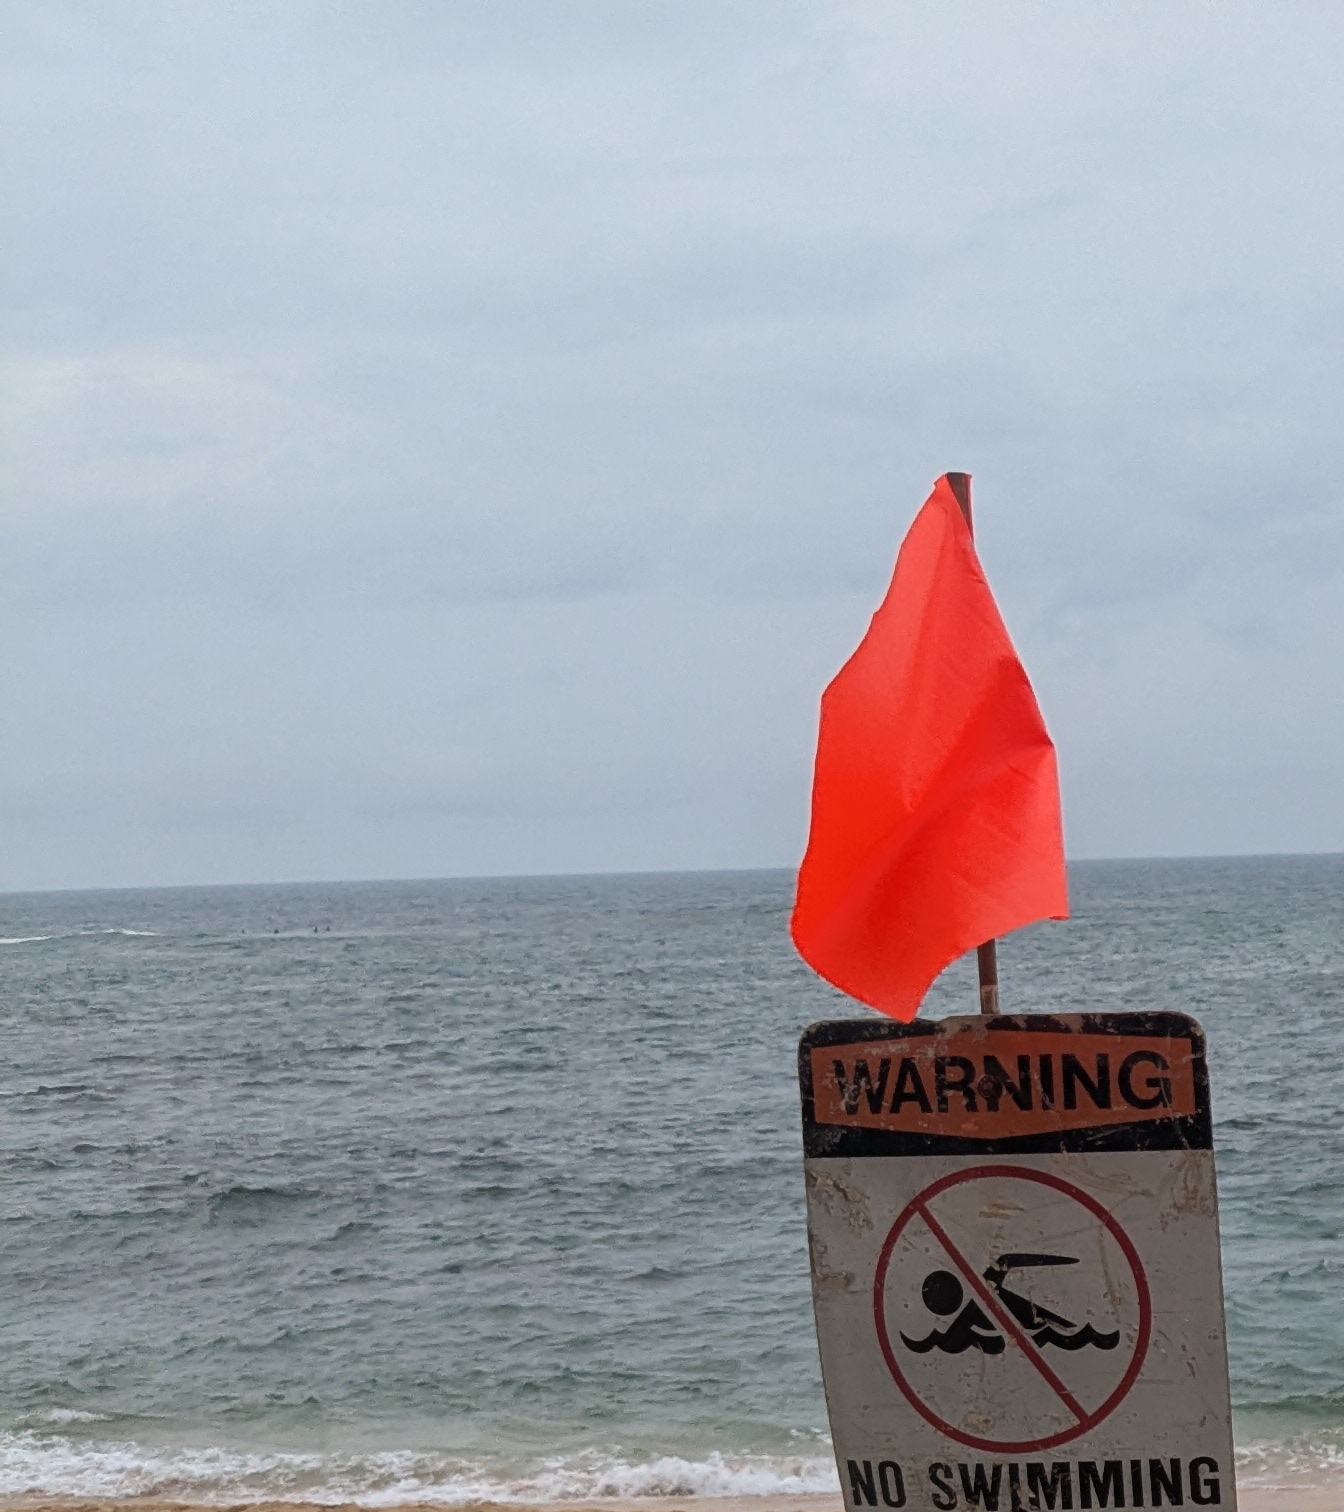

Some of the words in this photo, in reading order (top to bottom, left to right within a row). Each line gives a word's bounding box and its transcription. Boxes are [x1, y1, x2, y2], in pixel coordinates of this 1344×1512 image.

[832, 1050, 1173, 1116] WARNING
[846, 1459, 906, 1508] NO
[928, 1457, 1221, 1511] SWIMMING
